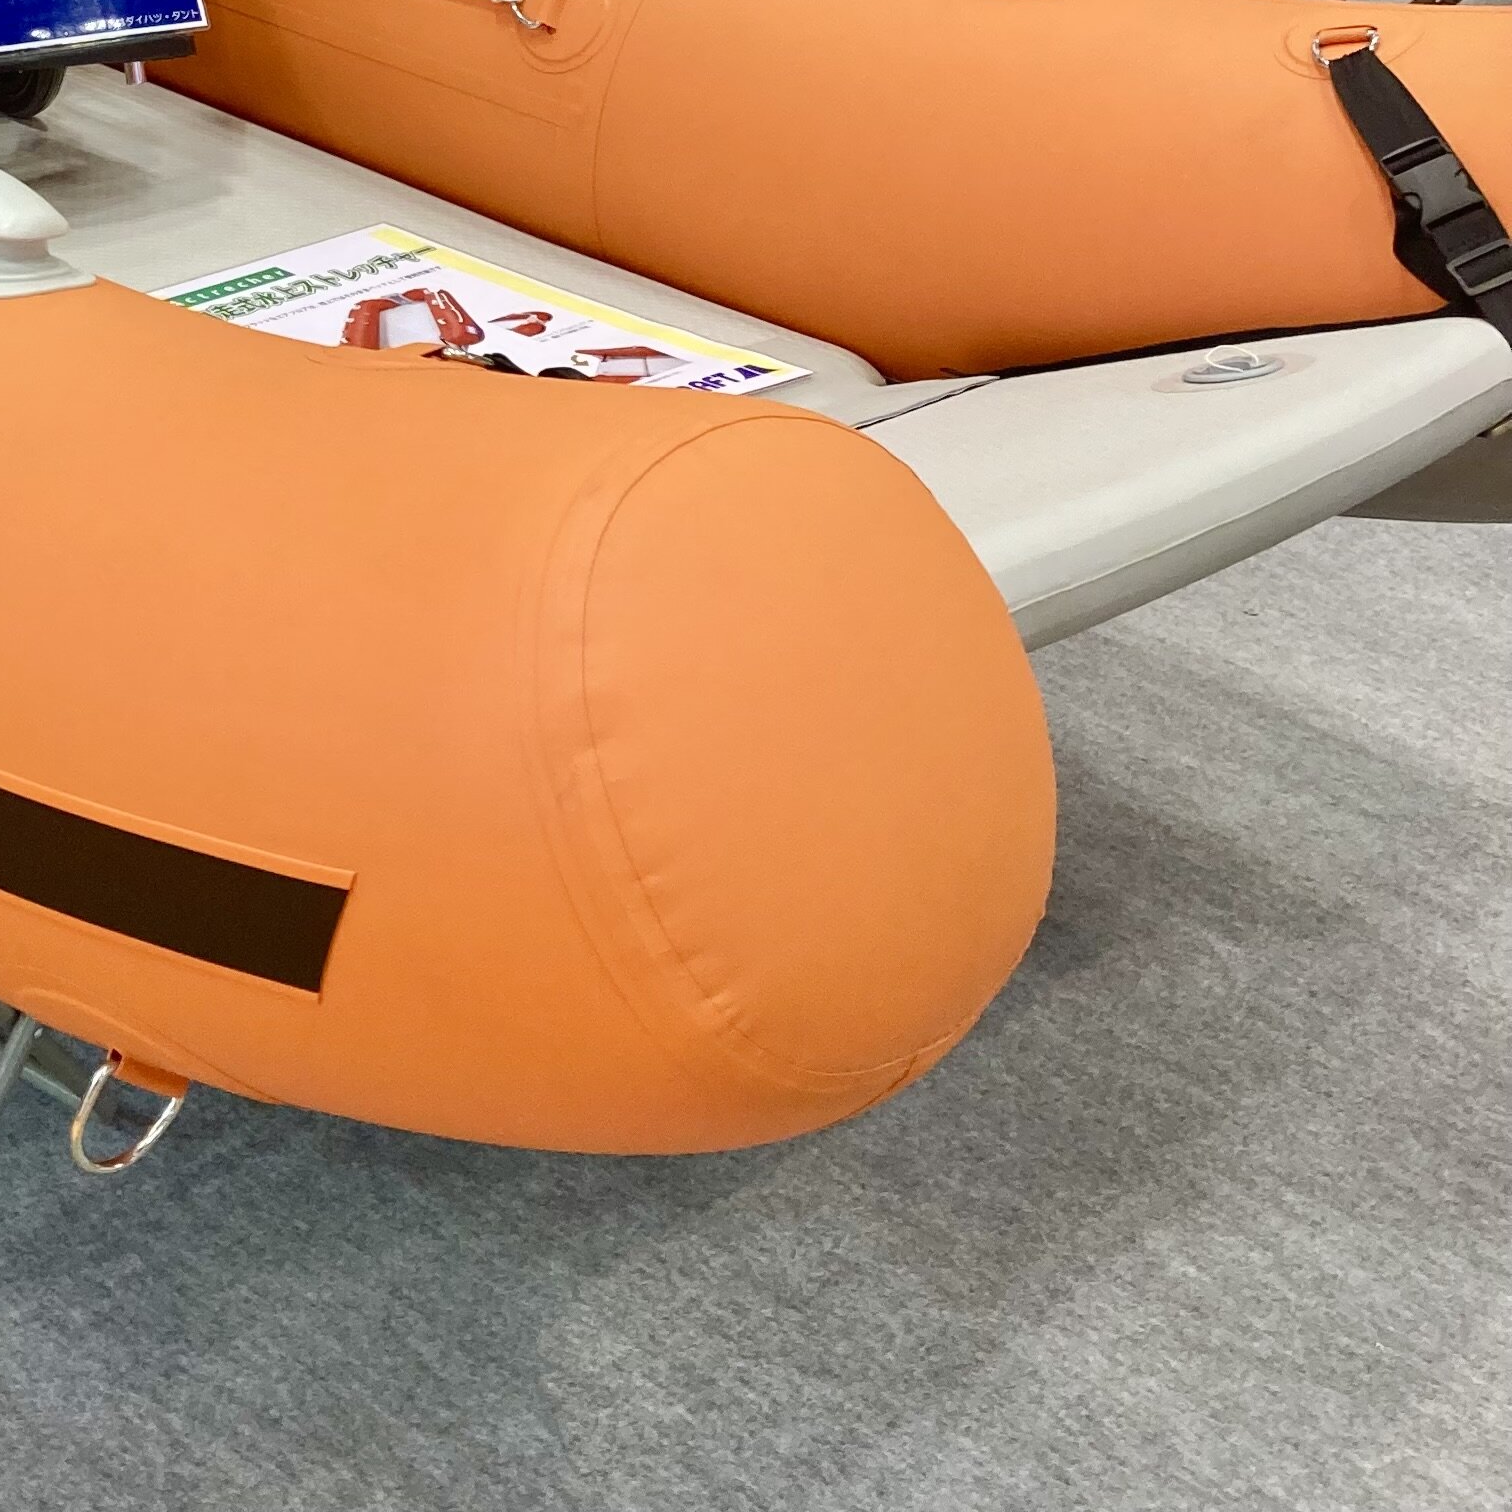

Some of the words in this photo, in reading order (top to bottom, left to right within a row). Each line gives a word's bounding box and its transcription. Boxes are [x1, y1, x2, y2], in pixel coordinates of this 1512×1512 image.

[203, 245, 437, 322] 走式水上ストレッチャー
[676, 372, 740, 392] AFT
